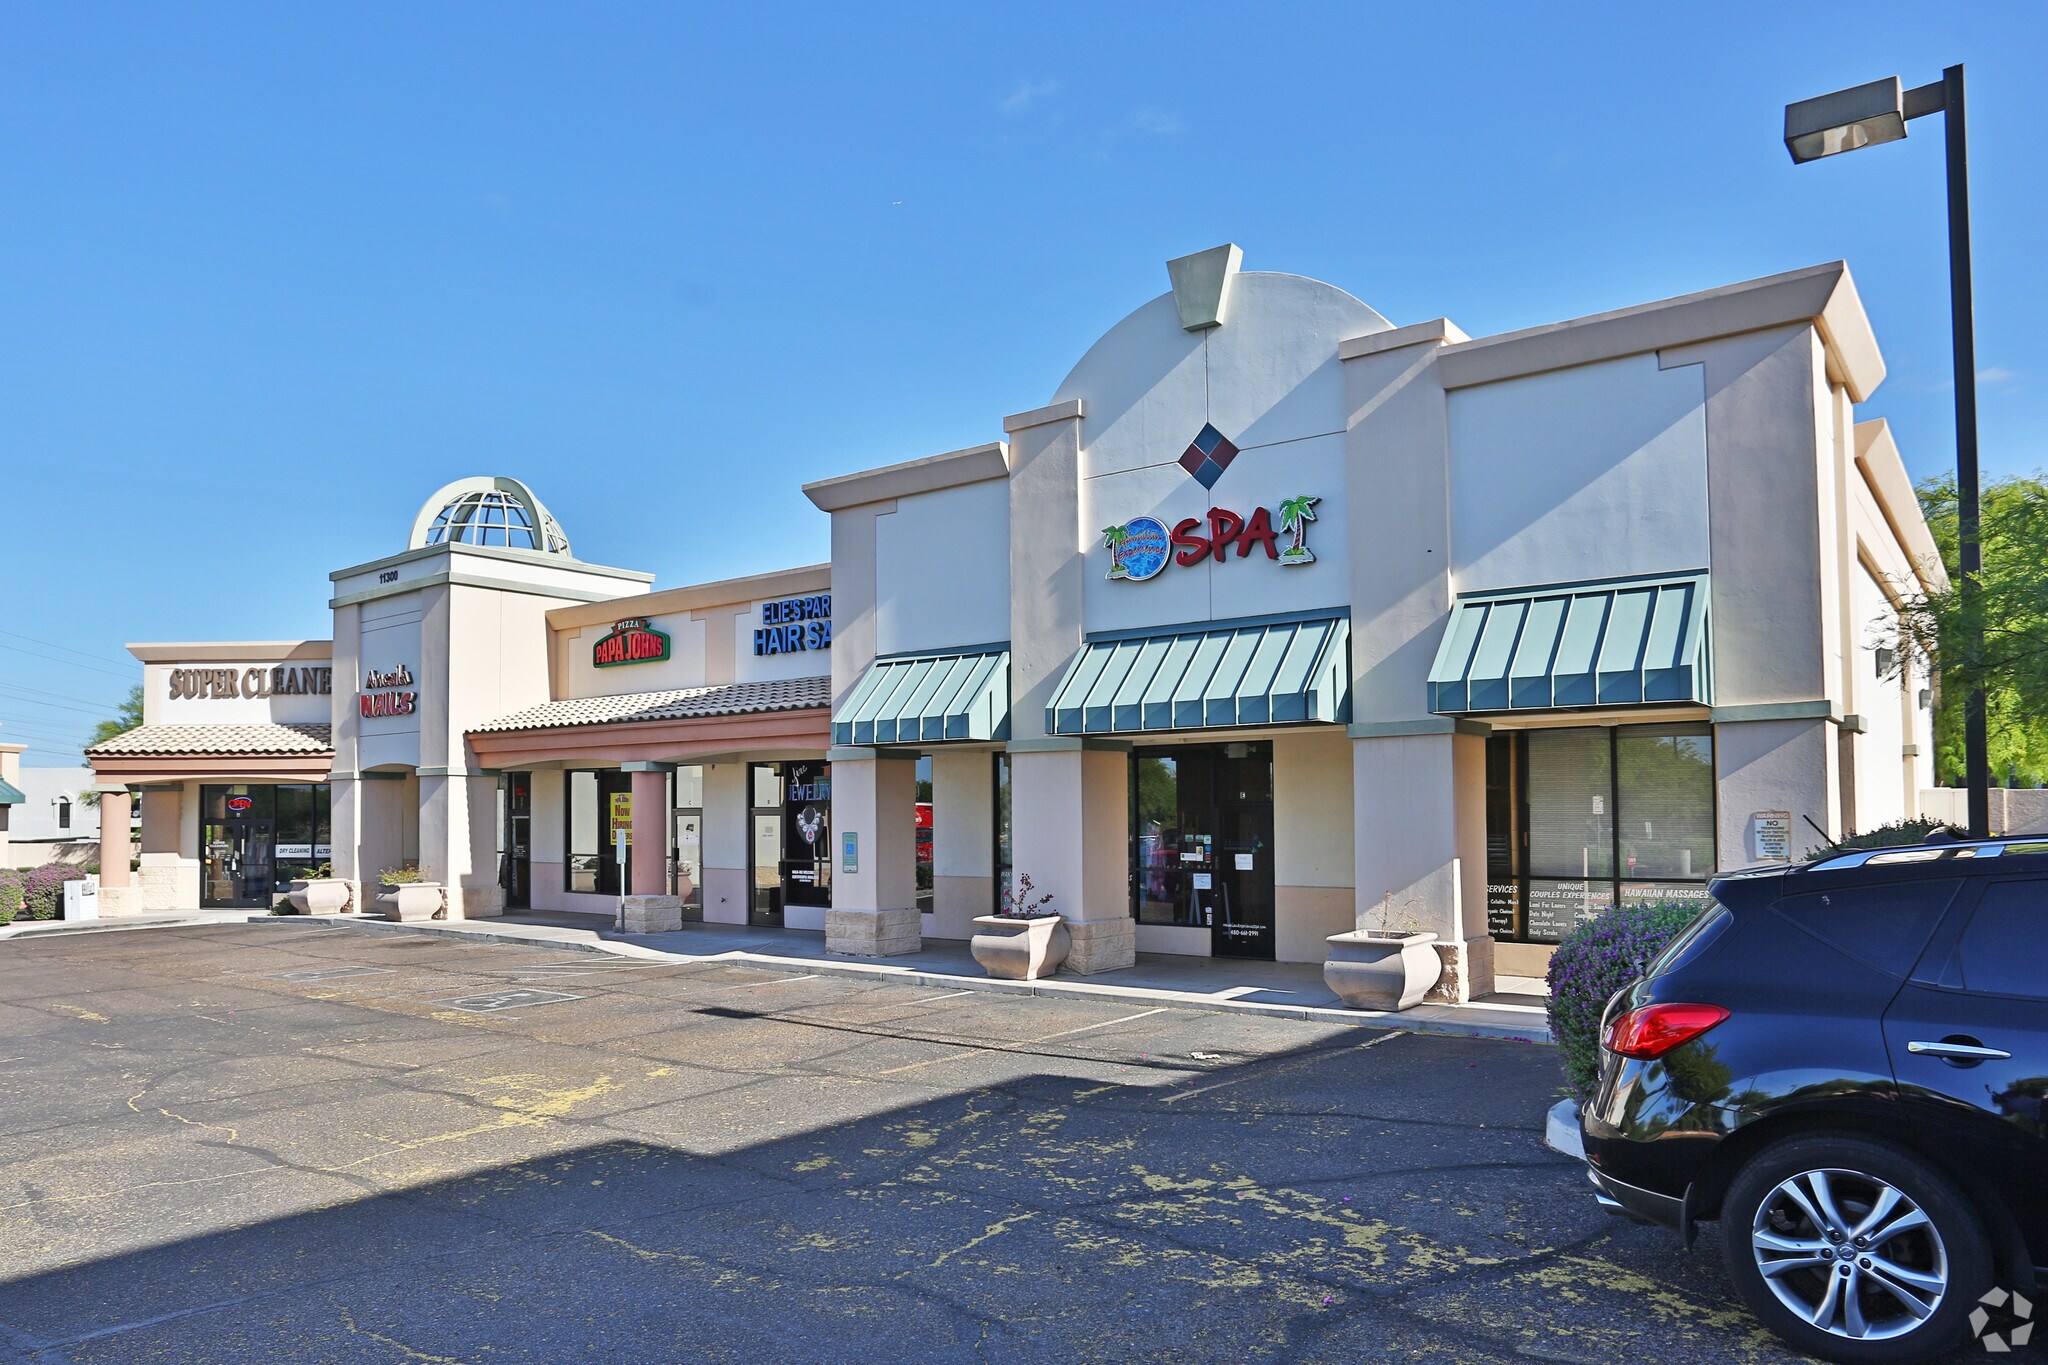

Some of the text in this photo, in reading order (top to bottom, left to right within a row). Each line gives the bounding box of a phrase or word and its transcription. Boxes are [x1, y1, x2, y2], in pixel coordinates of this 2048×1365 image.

[1171, 506, 1279, 567] SPA
[379, 570, 398, 584] 11300
[763, 599, 804, 625] ELIE'S
[617, 620, 639, 630] PIZZA
[596, 635, 624, 663] PAPA
[754, 624, 805, 656] HAIR
[169, 668, 240, 700] SUPER
[360, 692, 417, 719] NAILS
[788, 784, 831, 801] JEWELRY
[228, 800, 252, 809] OPEN
[1529, 891, 1611, 900] COUPLES EXPERENCES
[1624, 888, 1709, 898] HAWAIIAN MASSAGES
